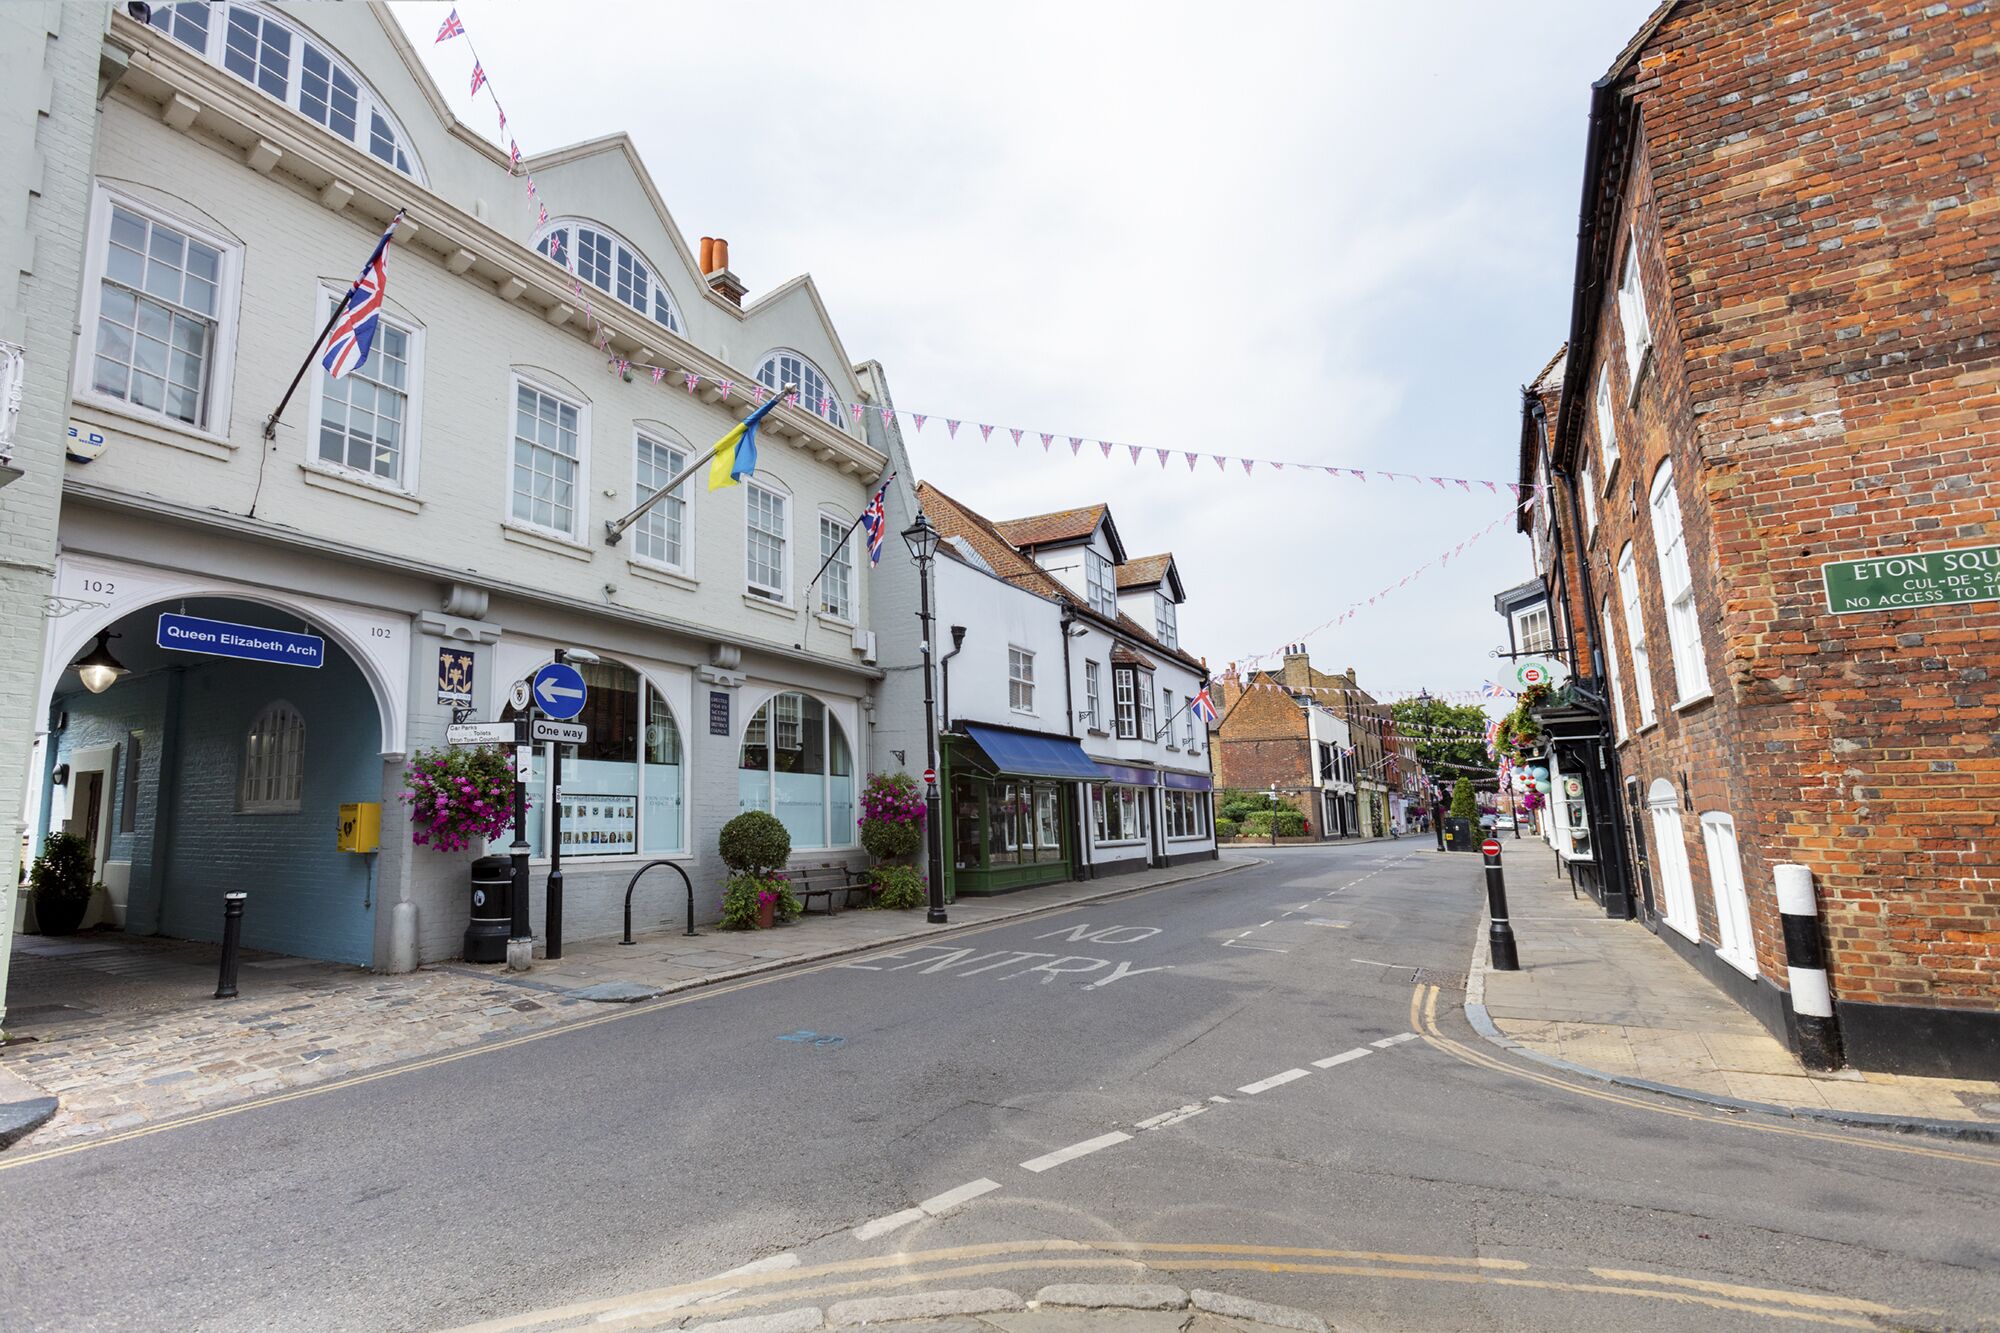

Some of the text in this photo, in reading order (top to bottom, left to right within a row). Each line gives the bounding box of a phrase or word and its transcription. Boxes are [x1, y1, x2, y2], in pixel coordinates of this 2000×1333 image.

[1853, 557, 1929, 581] ETON
[84, 579, 115, 595] 102
[1846, 597, 1870, 608] NO
[1878, 590, 1944, 606] ACCESS
[1952, 586, 1977, 599] TO
[167, 626, 317, 657] Queen Elizabeth Arch
[371, 627, 391, 639] 102
[537, 724, 583, 740] One way
[1033, 923, 1162, 944] NO
[834, 945, 1176, 991] ENTRY
